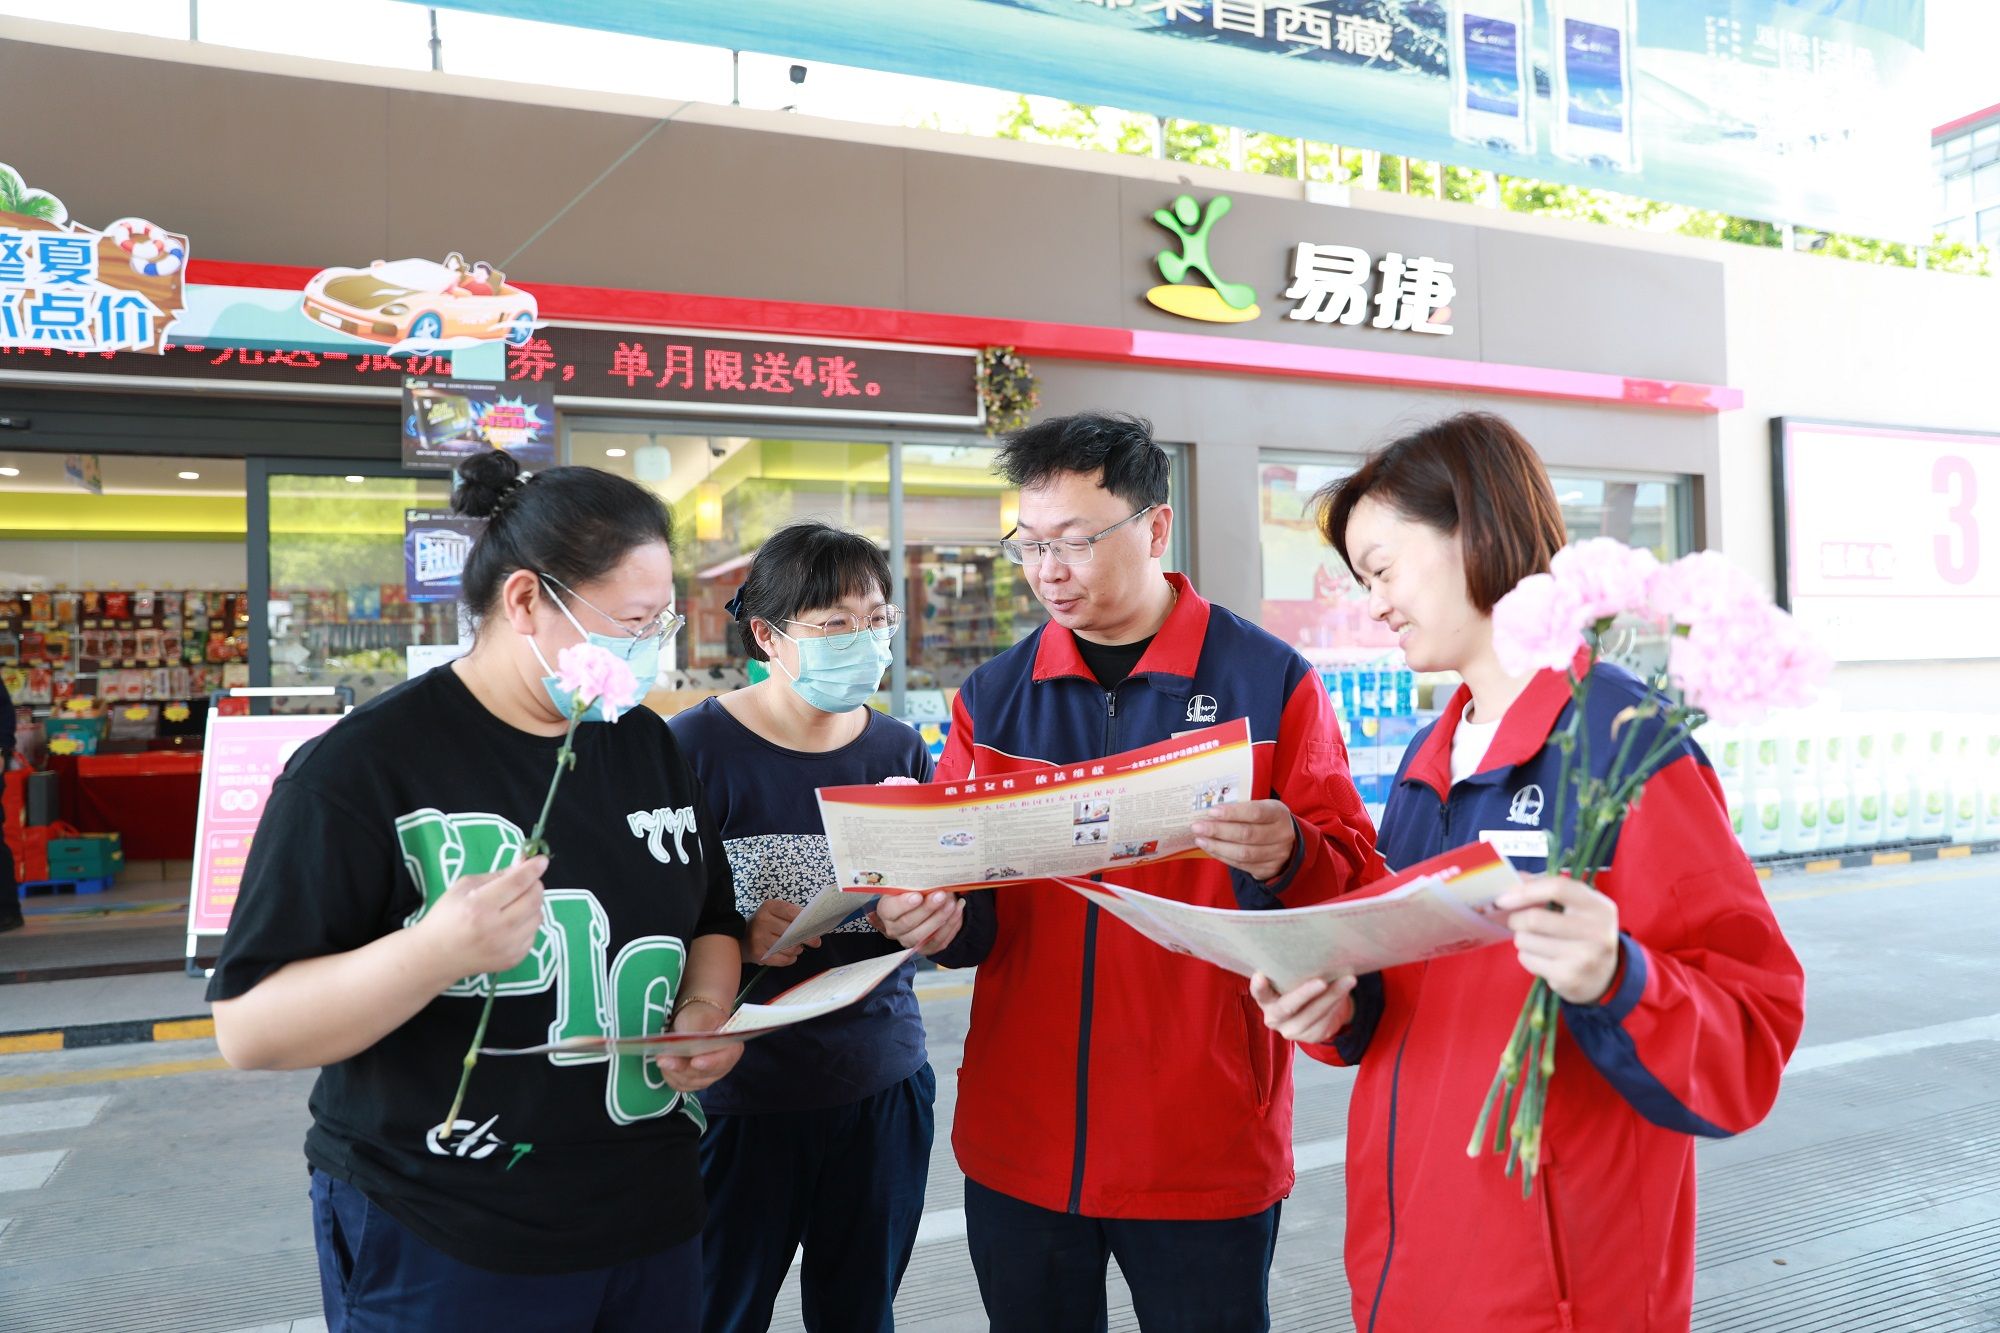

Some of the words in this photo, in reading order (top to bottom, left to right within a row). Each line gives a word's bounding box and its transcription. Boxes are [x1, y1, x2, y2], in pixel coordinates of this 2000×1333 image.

[1076, 0, 1395, 62] 自西藏
[1285, 241, 1457, 335] 易捷
